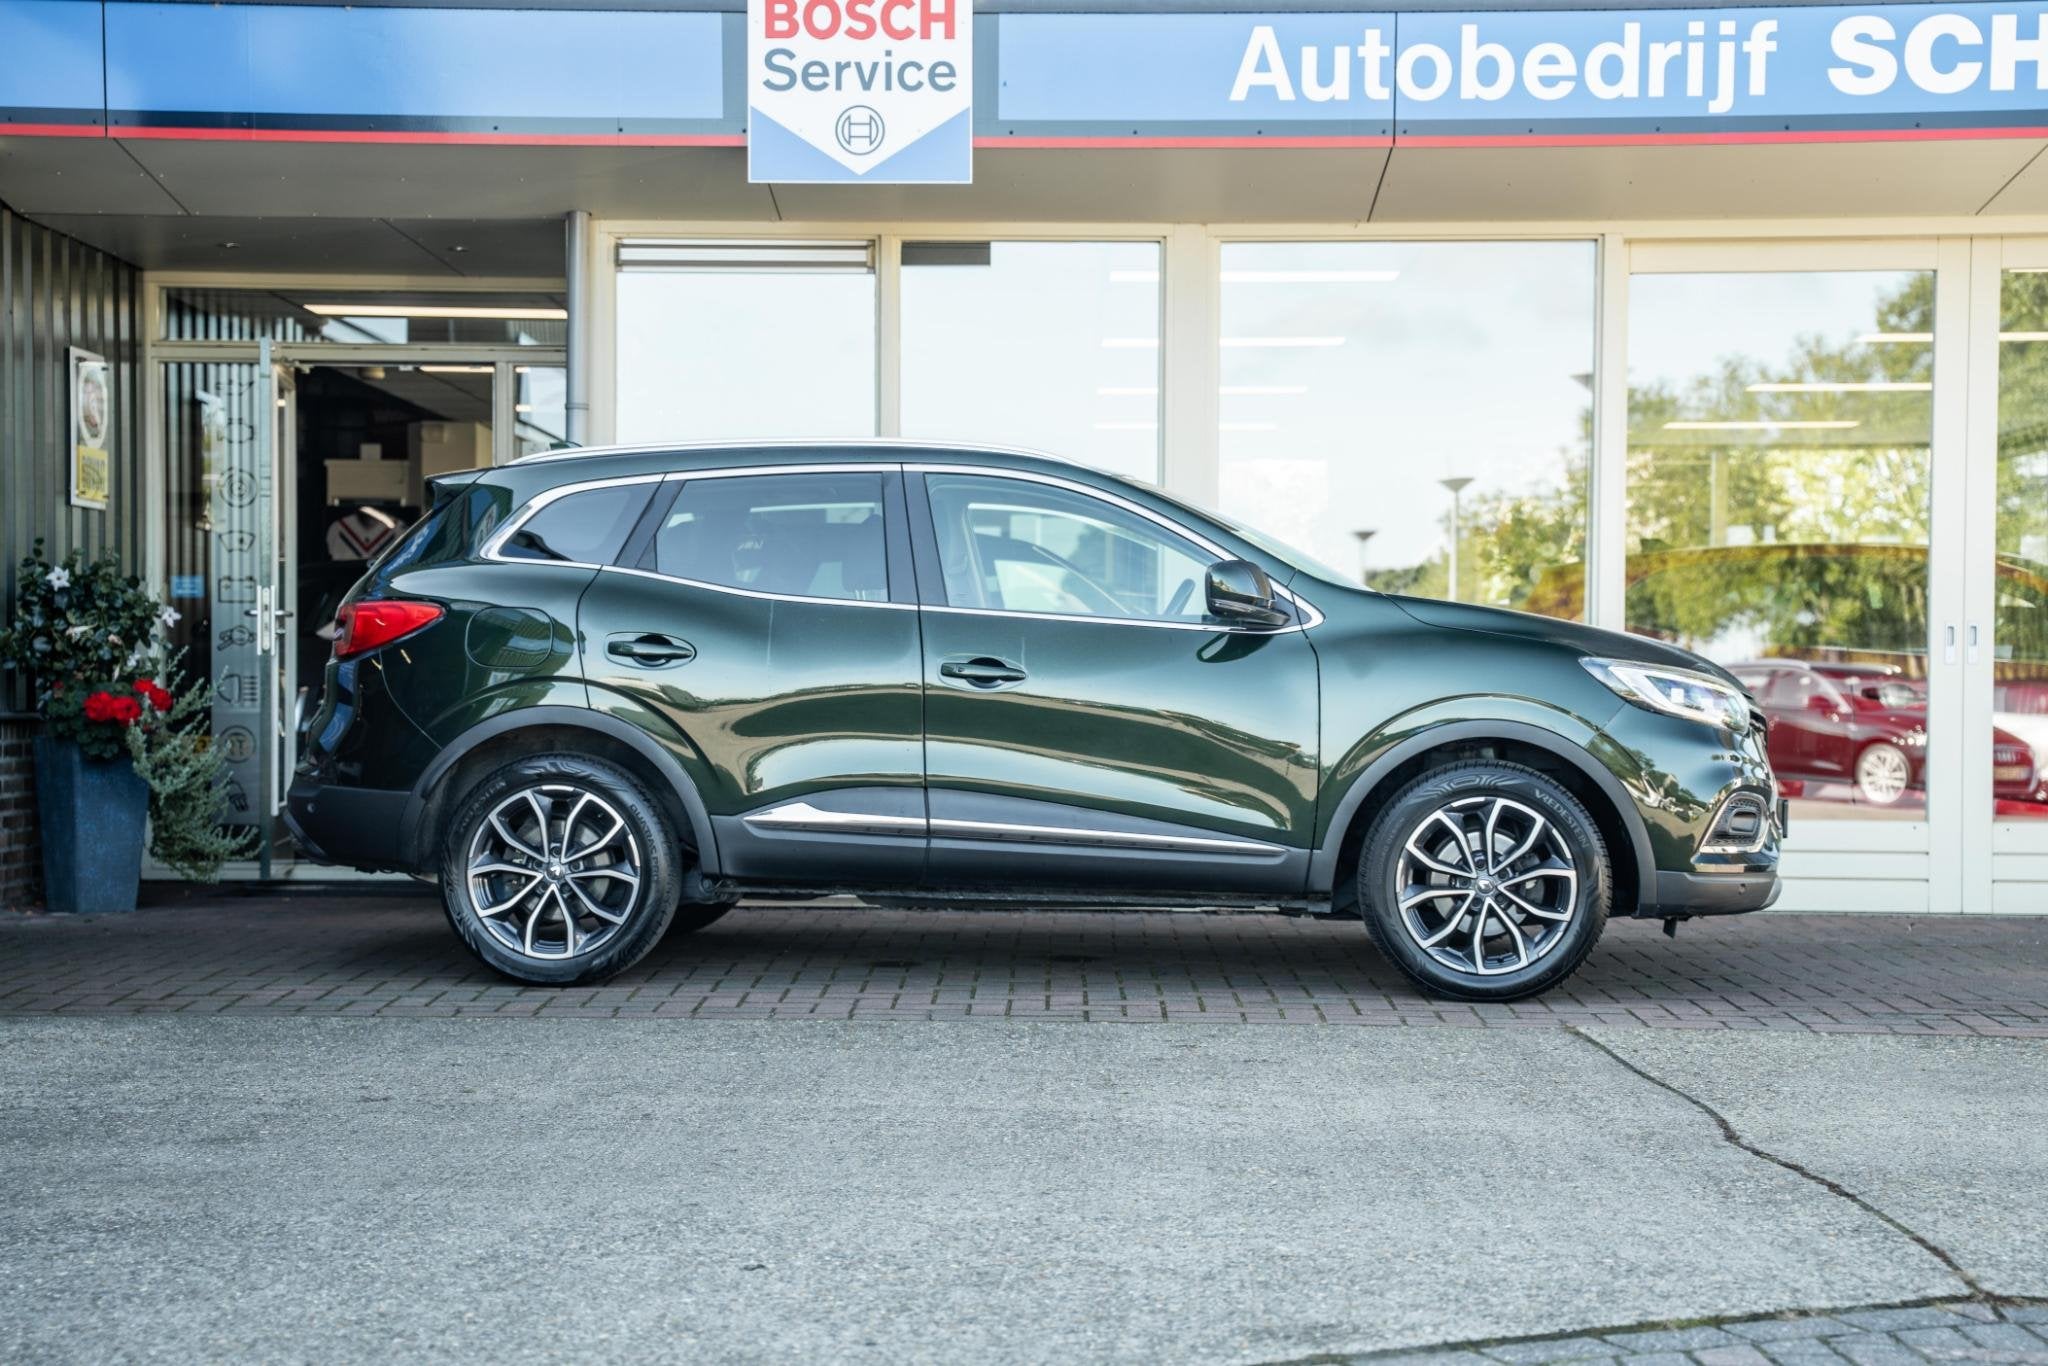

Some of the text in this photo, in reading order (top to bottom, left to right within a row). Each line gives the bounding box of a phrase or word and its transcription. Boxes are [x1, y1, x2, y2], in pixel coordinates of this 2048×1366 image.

[764, 0, 956, 40] BOSCH
[763, 48, 956, 92] Service
[1229, 13, 2048, 113] Autobedrijf SCH
[1534, 788, 1590, 848] VREDESTEIN
